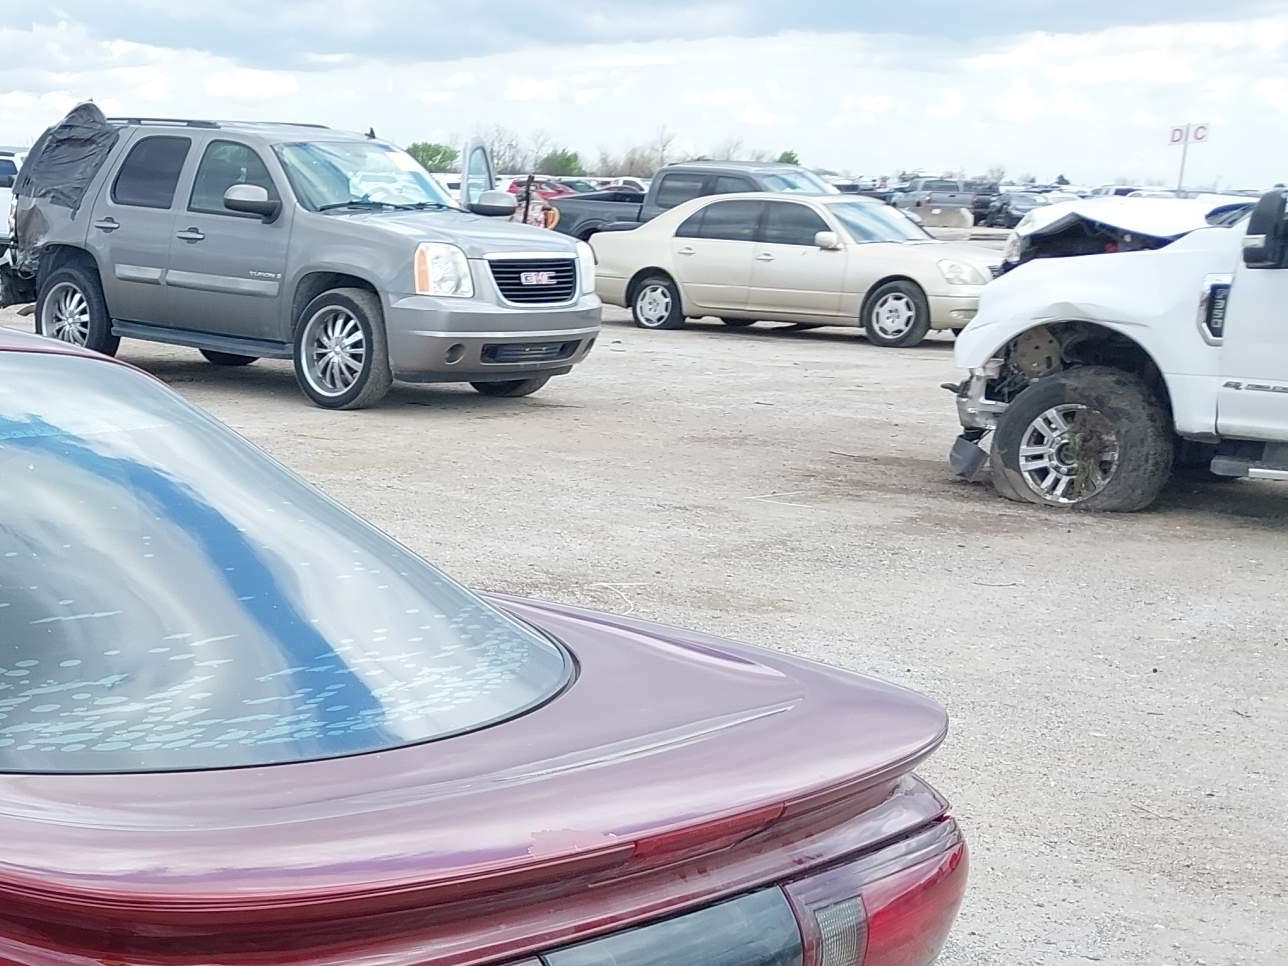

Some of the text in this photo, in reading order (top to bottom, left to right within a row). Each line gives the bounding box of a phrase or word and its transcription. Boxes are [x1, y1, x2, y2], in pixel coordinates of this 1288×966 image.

[1171, 125, 1207, 142] D C
[520, 271, 557, 284] GMC
